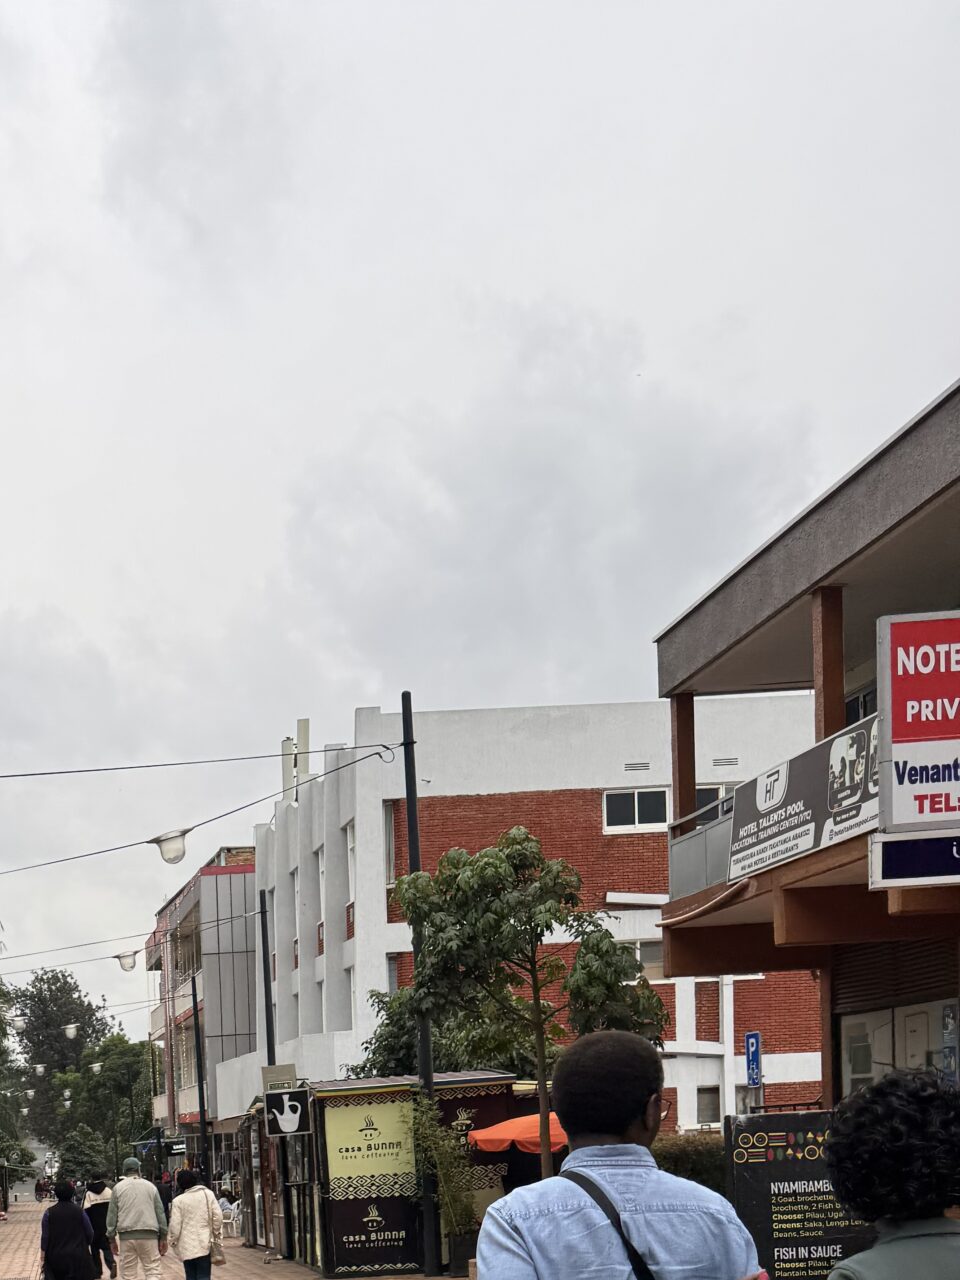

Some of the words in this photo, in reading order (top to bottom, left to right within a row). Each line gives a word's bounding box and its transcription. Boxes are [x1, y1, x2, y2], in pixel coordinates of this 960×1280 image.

[906, 697, 960, 722] PRIV
[739, 821, 758, 839] HOTEL
[759, 807, 786, 830] TALENTS
[787, 799, 805, 818] POOL
[339, 1145, 362, 1153] casa
[772, 1203, 811, 1211] brochette,
[772, 1212, 804, 1220] Choose:
[805, 1211, 827, 1219] Pilau,
[772, 1221, 803, 1229] Greens:
[343, 1234, 367, 1242] casa
[774, 1247, 797, 1260] FISH
[798, 1246, 809, 1259] IN
[810, 1244, 843, 1259] SAUCE
[774, 1261, 807, 1269] Choose:
[775, 1269, 807, 1277] Plantain
